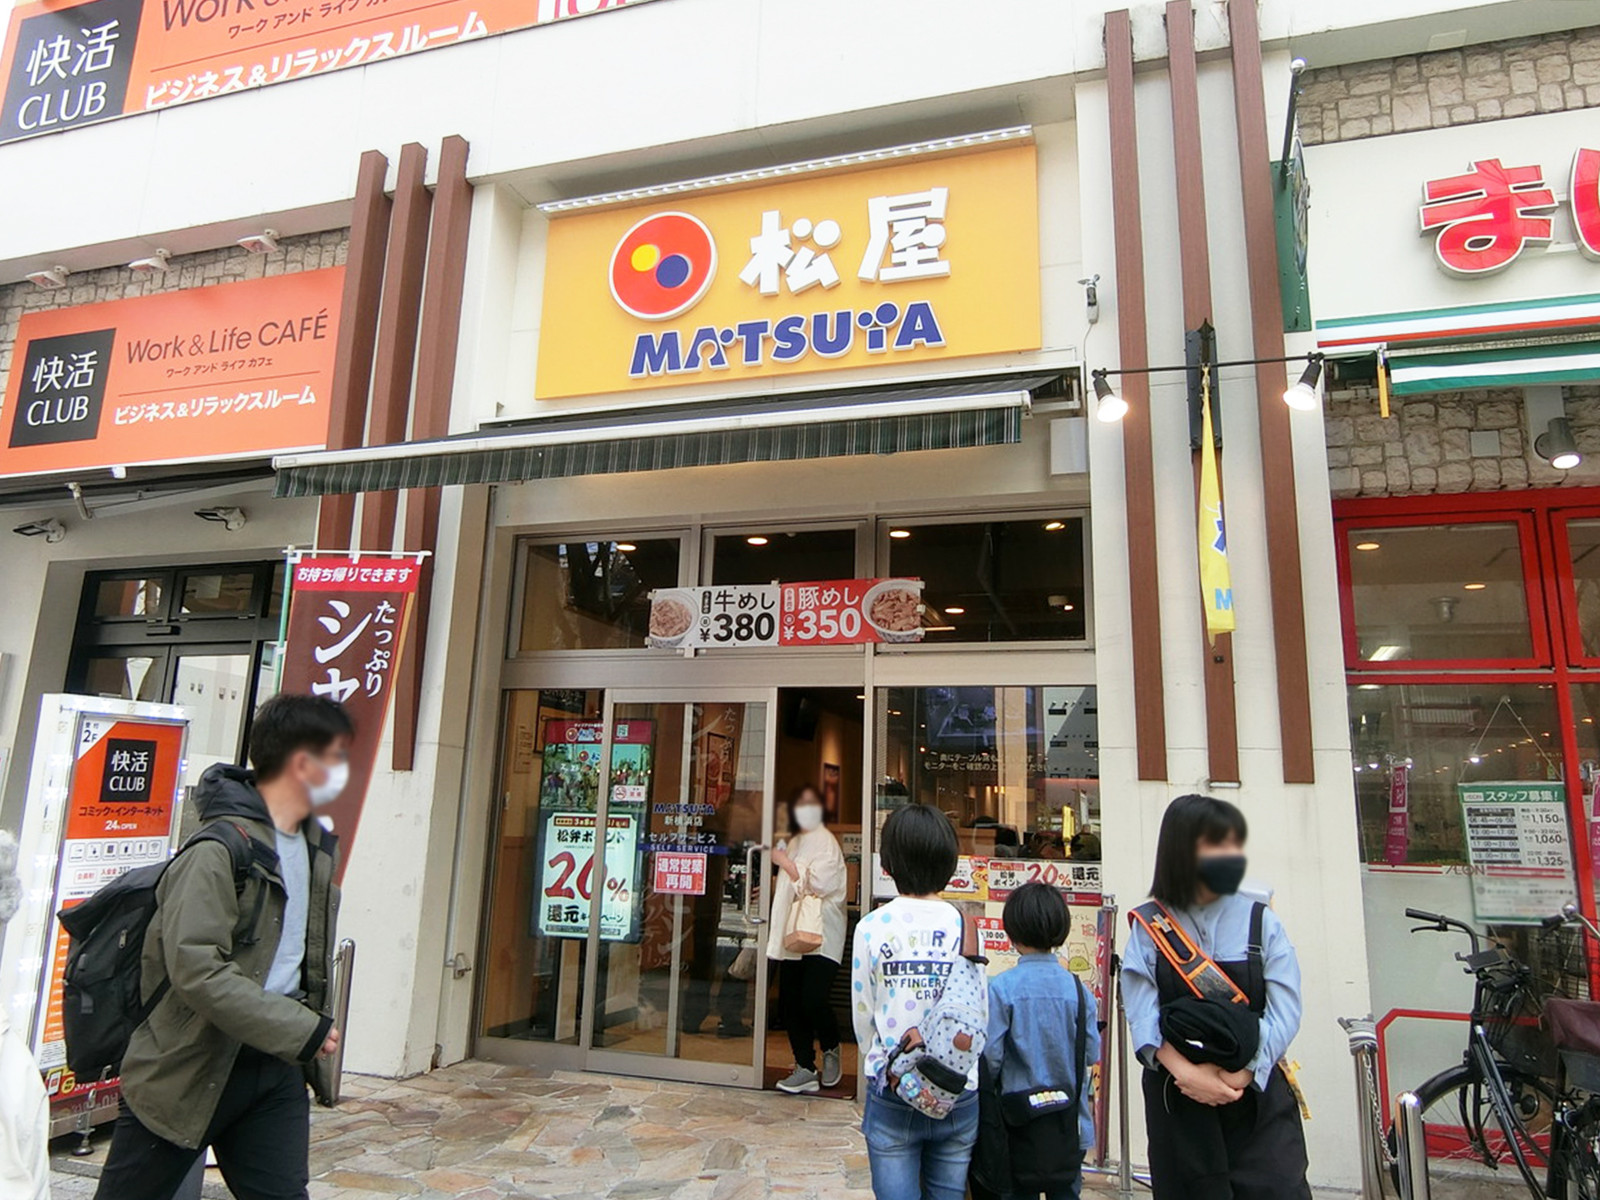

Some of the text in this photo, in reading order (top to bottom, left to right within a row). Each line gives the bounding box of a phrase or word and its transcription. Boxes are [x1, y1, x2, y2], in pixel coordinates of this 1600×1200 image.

[228, 19, 268, 39] ワーク
[273, 11, 312, 30] アンド
[26, 20, 120, 87] 快活
[145, 11, 489, 110] ビジネス&リラックスルーム
[18, 81, 107, 130] CLUB
[738, 187, 951, 297] 松屋
[127, 307, 328, 364] Work & Life CAFÉ
[629, 299, 947, 379] MATSUYA
[32, 350, 98, 394] 快活
[166, 356, 273, 378] ワーク アンド ライフ カフェ
[27, 396, 89, 427] CLUB
[114, 384, 317, 426] ビジネス&リラックスルーム
[297, 567, 413, 583] お持ち帰りできます
[714, 590, 775, 613] 牛めし
[798, 586, 860, 610] 豚めし
[700, 612, 776, 642] ¥380
[783, 607, 862, 640] ¥350
[364, 600, 397, 698] たっぷり
[111, 750, 149, 772] 快活
[109, 776, 146, 792] CLUB
[649, 832, 717, 844] セルフサービス
[676, 845, 715, 853] SERVICE
[658, 858, 703, 873] 通常営業
[666, 875, 693, 890] 再開
